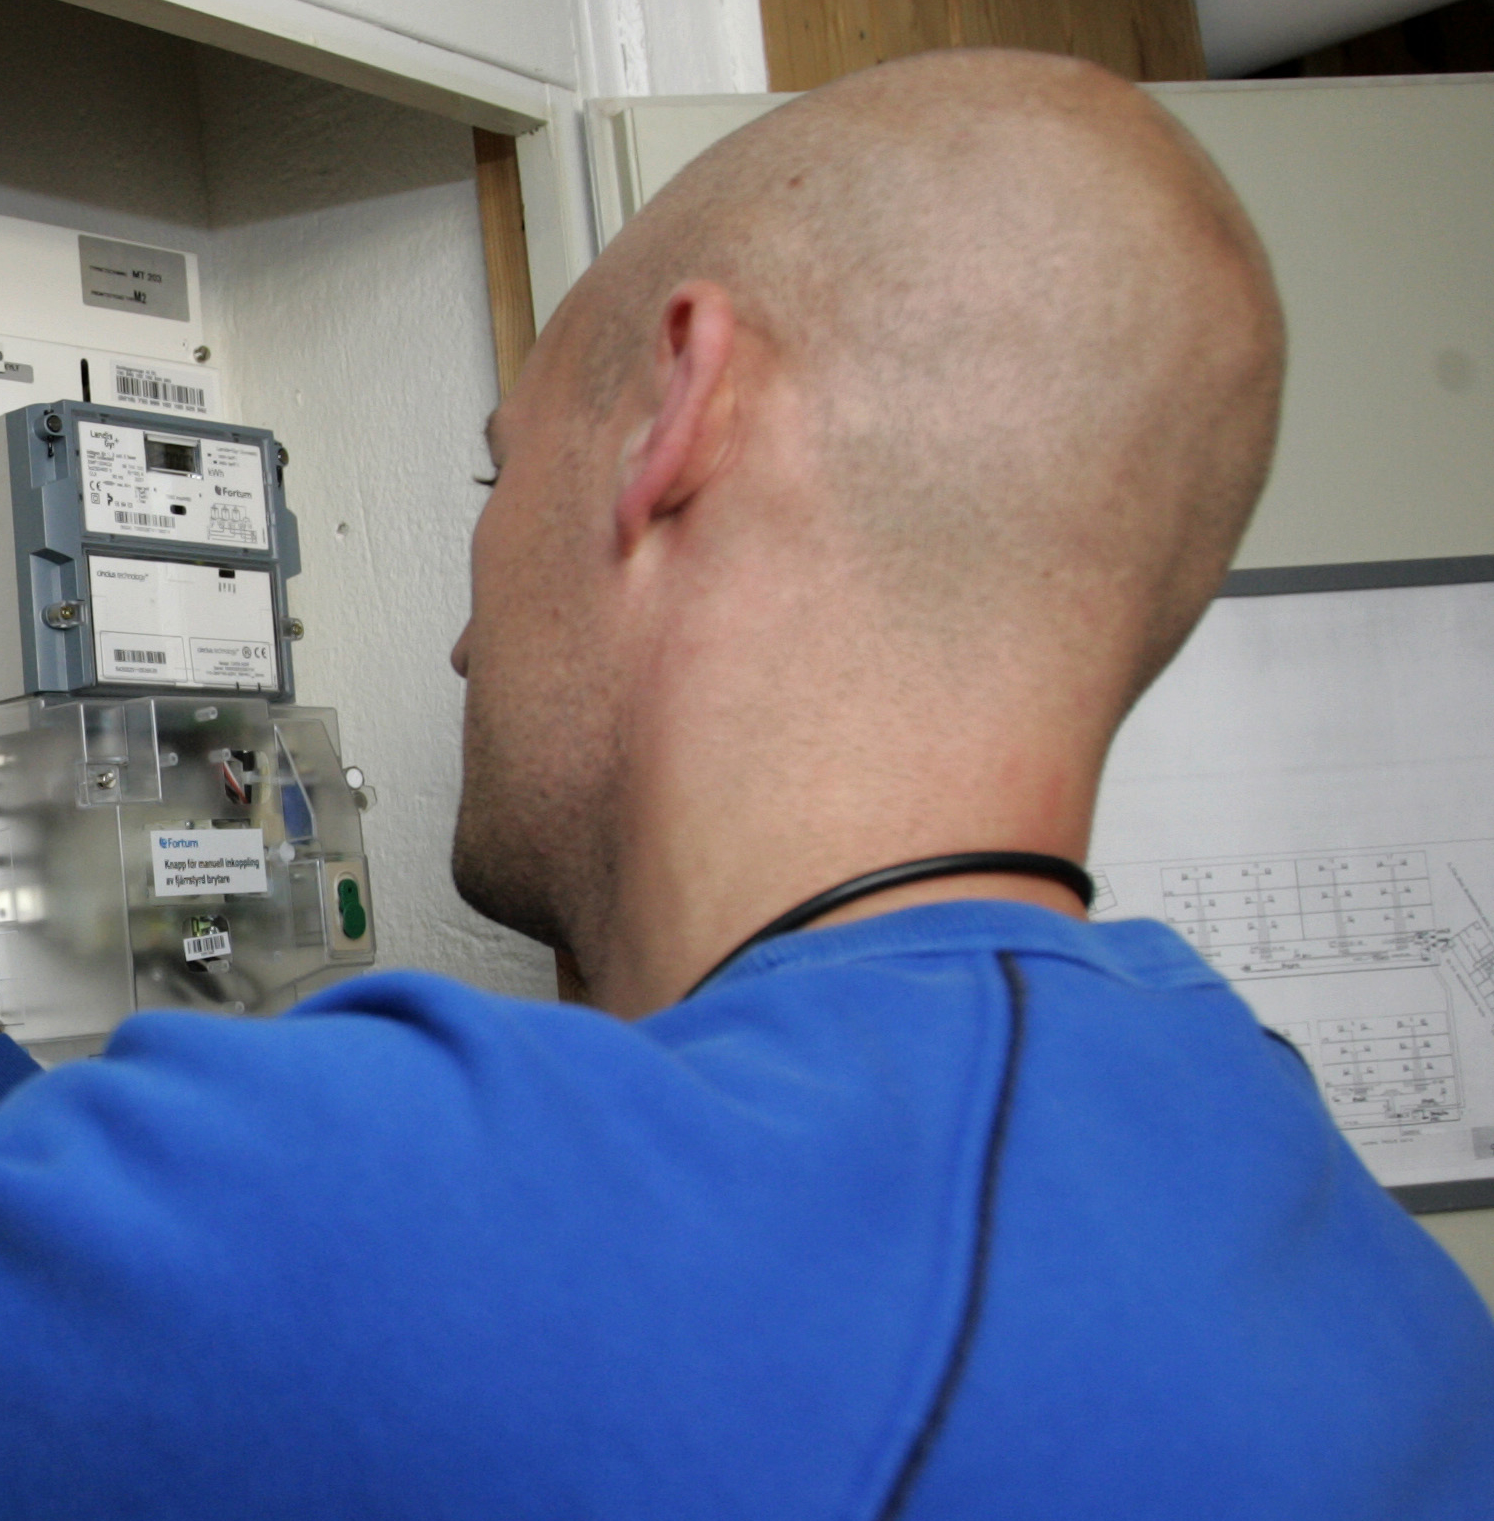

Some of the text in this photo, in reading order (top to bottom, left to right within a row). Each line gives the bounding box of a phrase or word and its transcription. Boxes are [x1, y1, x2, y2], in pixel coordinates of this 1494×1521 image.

[133, 289, 147, 305] M2
[222, 487, 252, 499] Fortum
[168, 837, 199, 848] Fortum
[165, 860, 187, 871] Knapp
